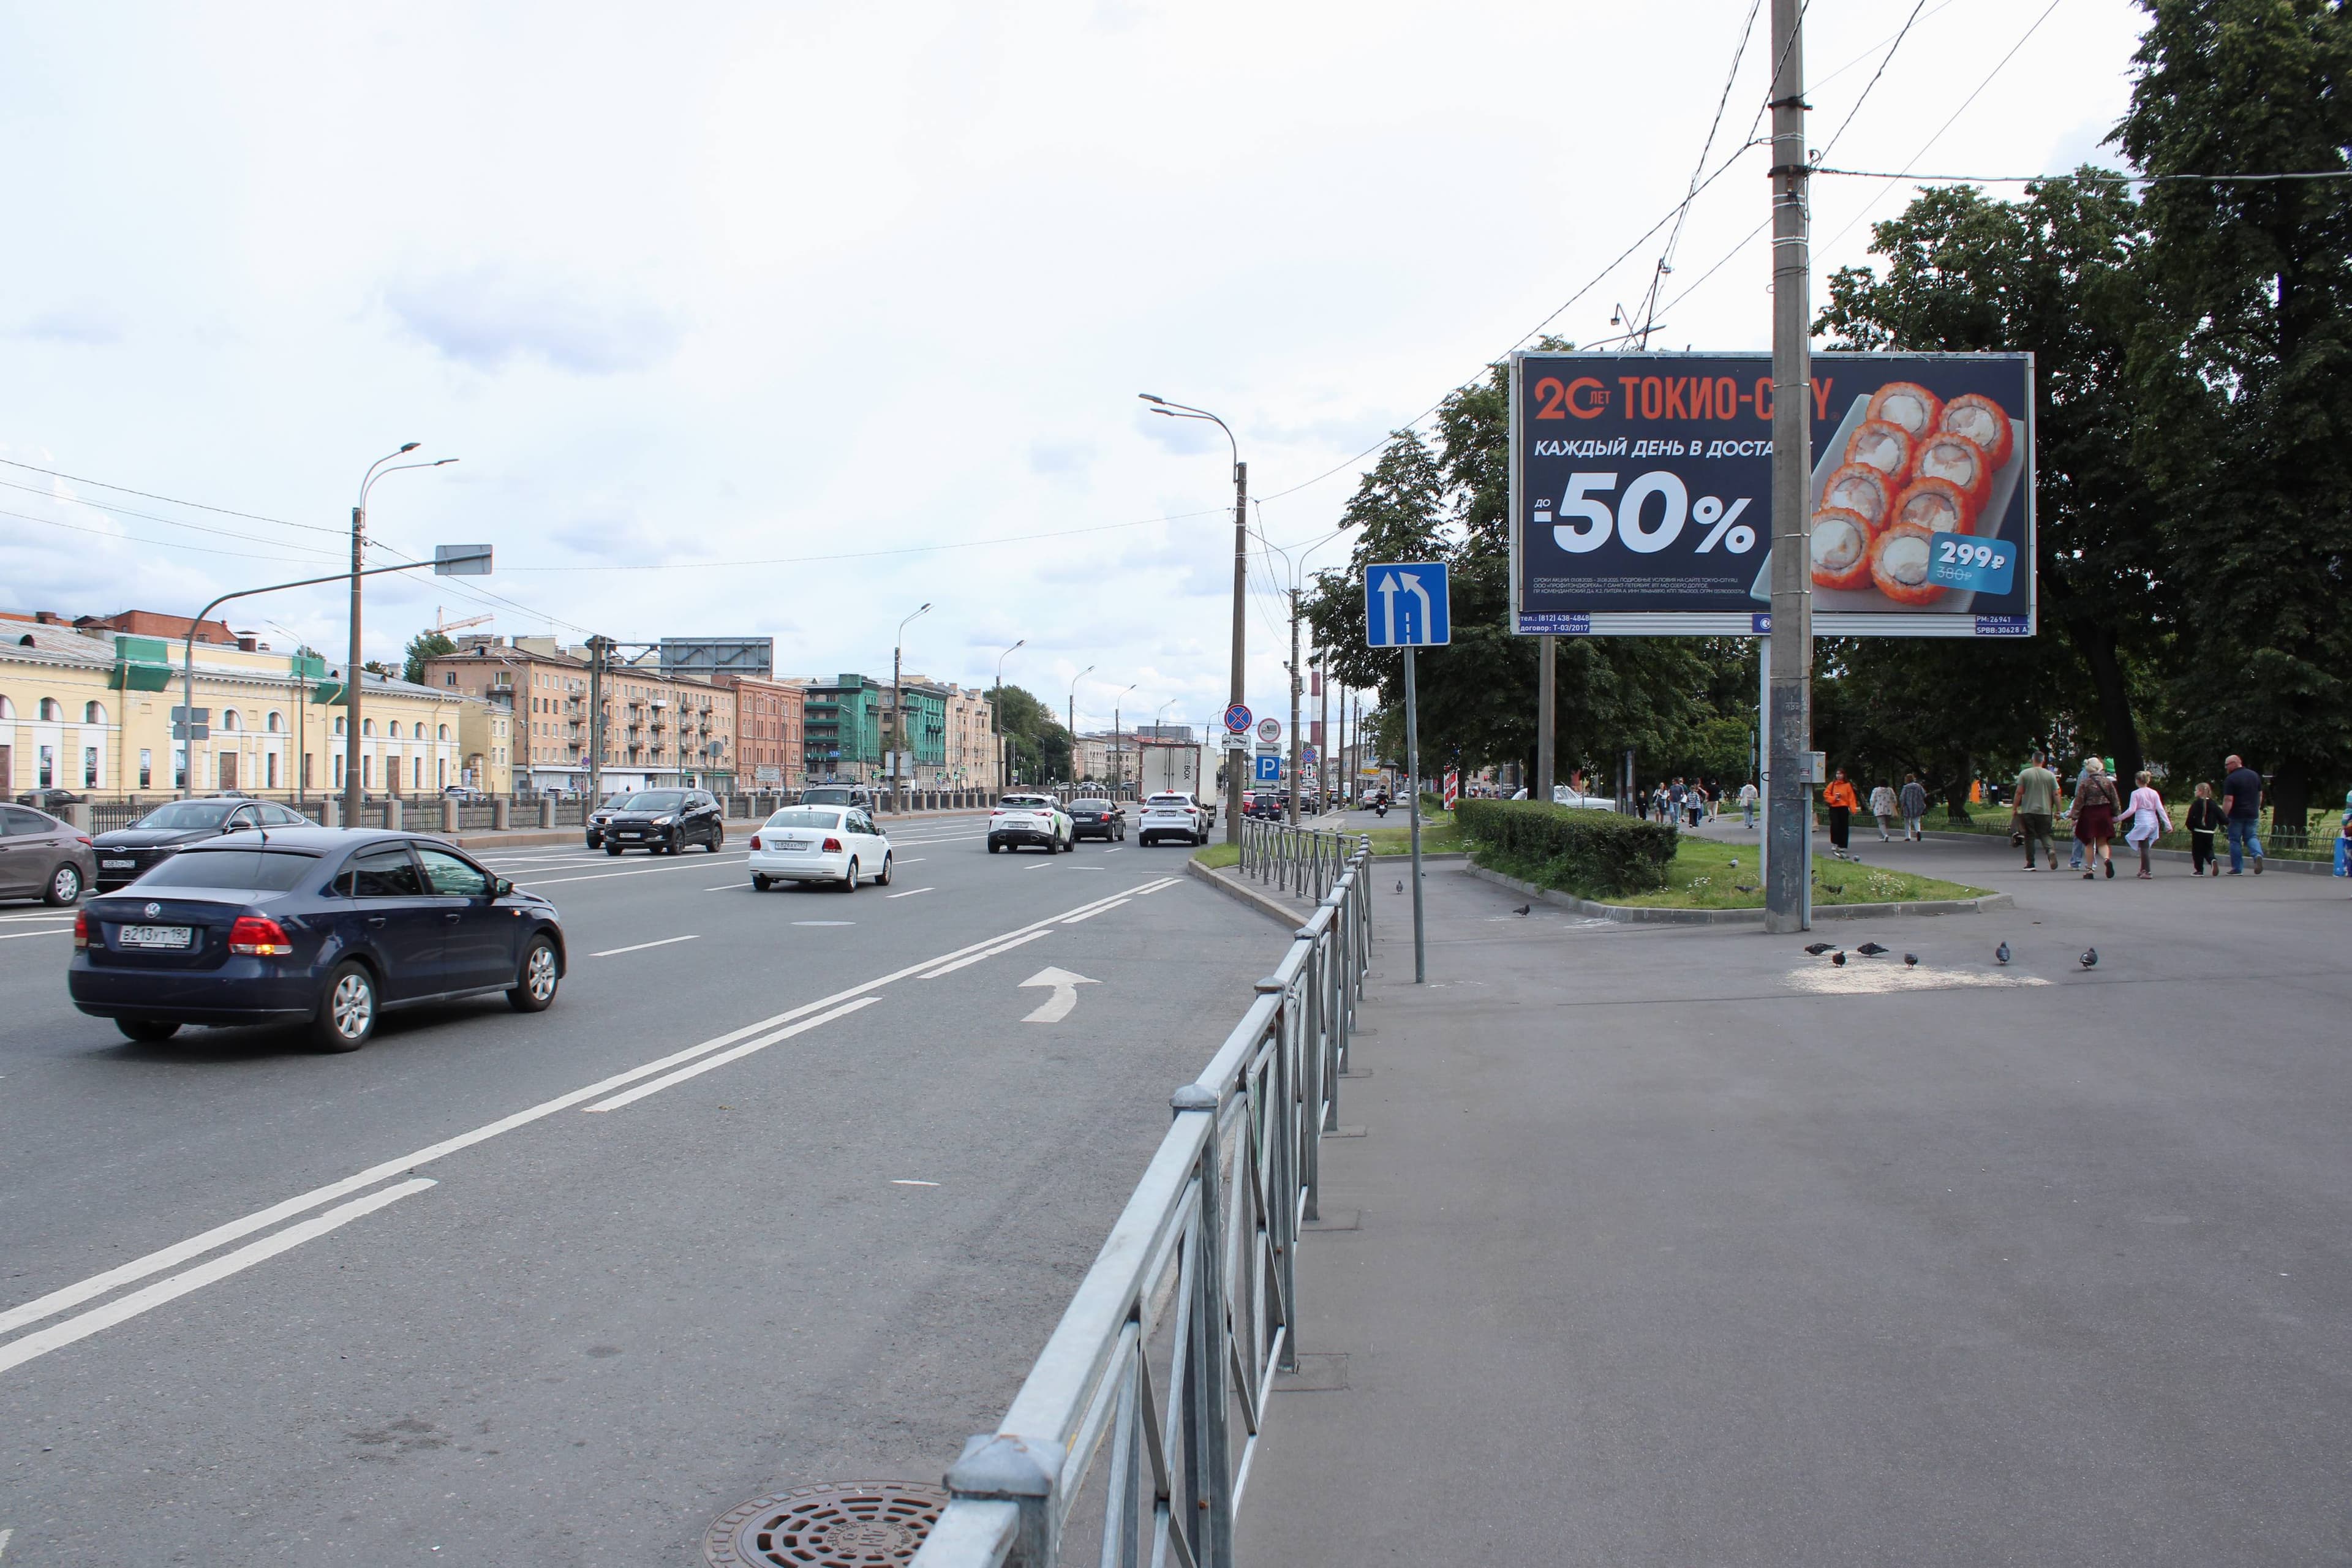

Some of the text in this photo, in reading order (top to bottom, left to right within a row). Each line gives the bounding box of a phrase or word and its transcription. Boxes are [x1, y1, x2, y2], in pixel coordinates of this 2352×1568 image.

[1534, 377, 1833, 420] 20 ЛЕТ ТОКИО-CY
[1534, 437, 1813, 458] КАЖДЫЙ ДЕНЬ В ДОСТА
[1534, 499, 1551, 508] ДО
[1534, 470, 1756, 554] -50%
[1262, 758, 1276, 778] P
